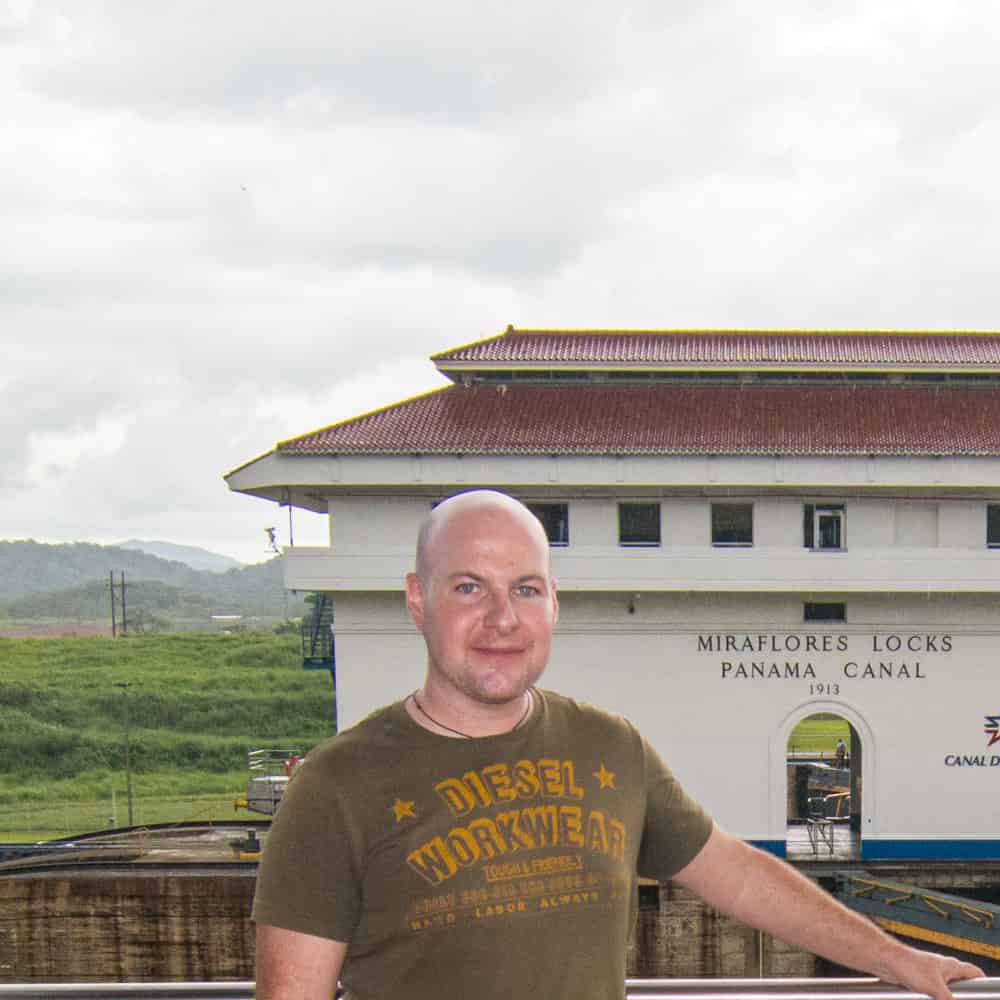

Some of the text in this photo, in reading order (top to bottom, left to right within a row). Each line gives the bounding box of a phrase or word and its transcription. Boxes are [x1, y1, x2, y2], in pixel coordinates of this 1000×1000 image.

[698, 635, 953, 652] MIRAFLORES LOCKS
[721, 661, 926, 679] PANAMA CANAL
[808, 683, 840, 696] 1913
[944, 755, 986, 767] CANAL
[434, 759, 584, 817] DIESEL
[405, 805, 626, 887] WORKWEAR
